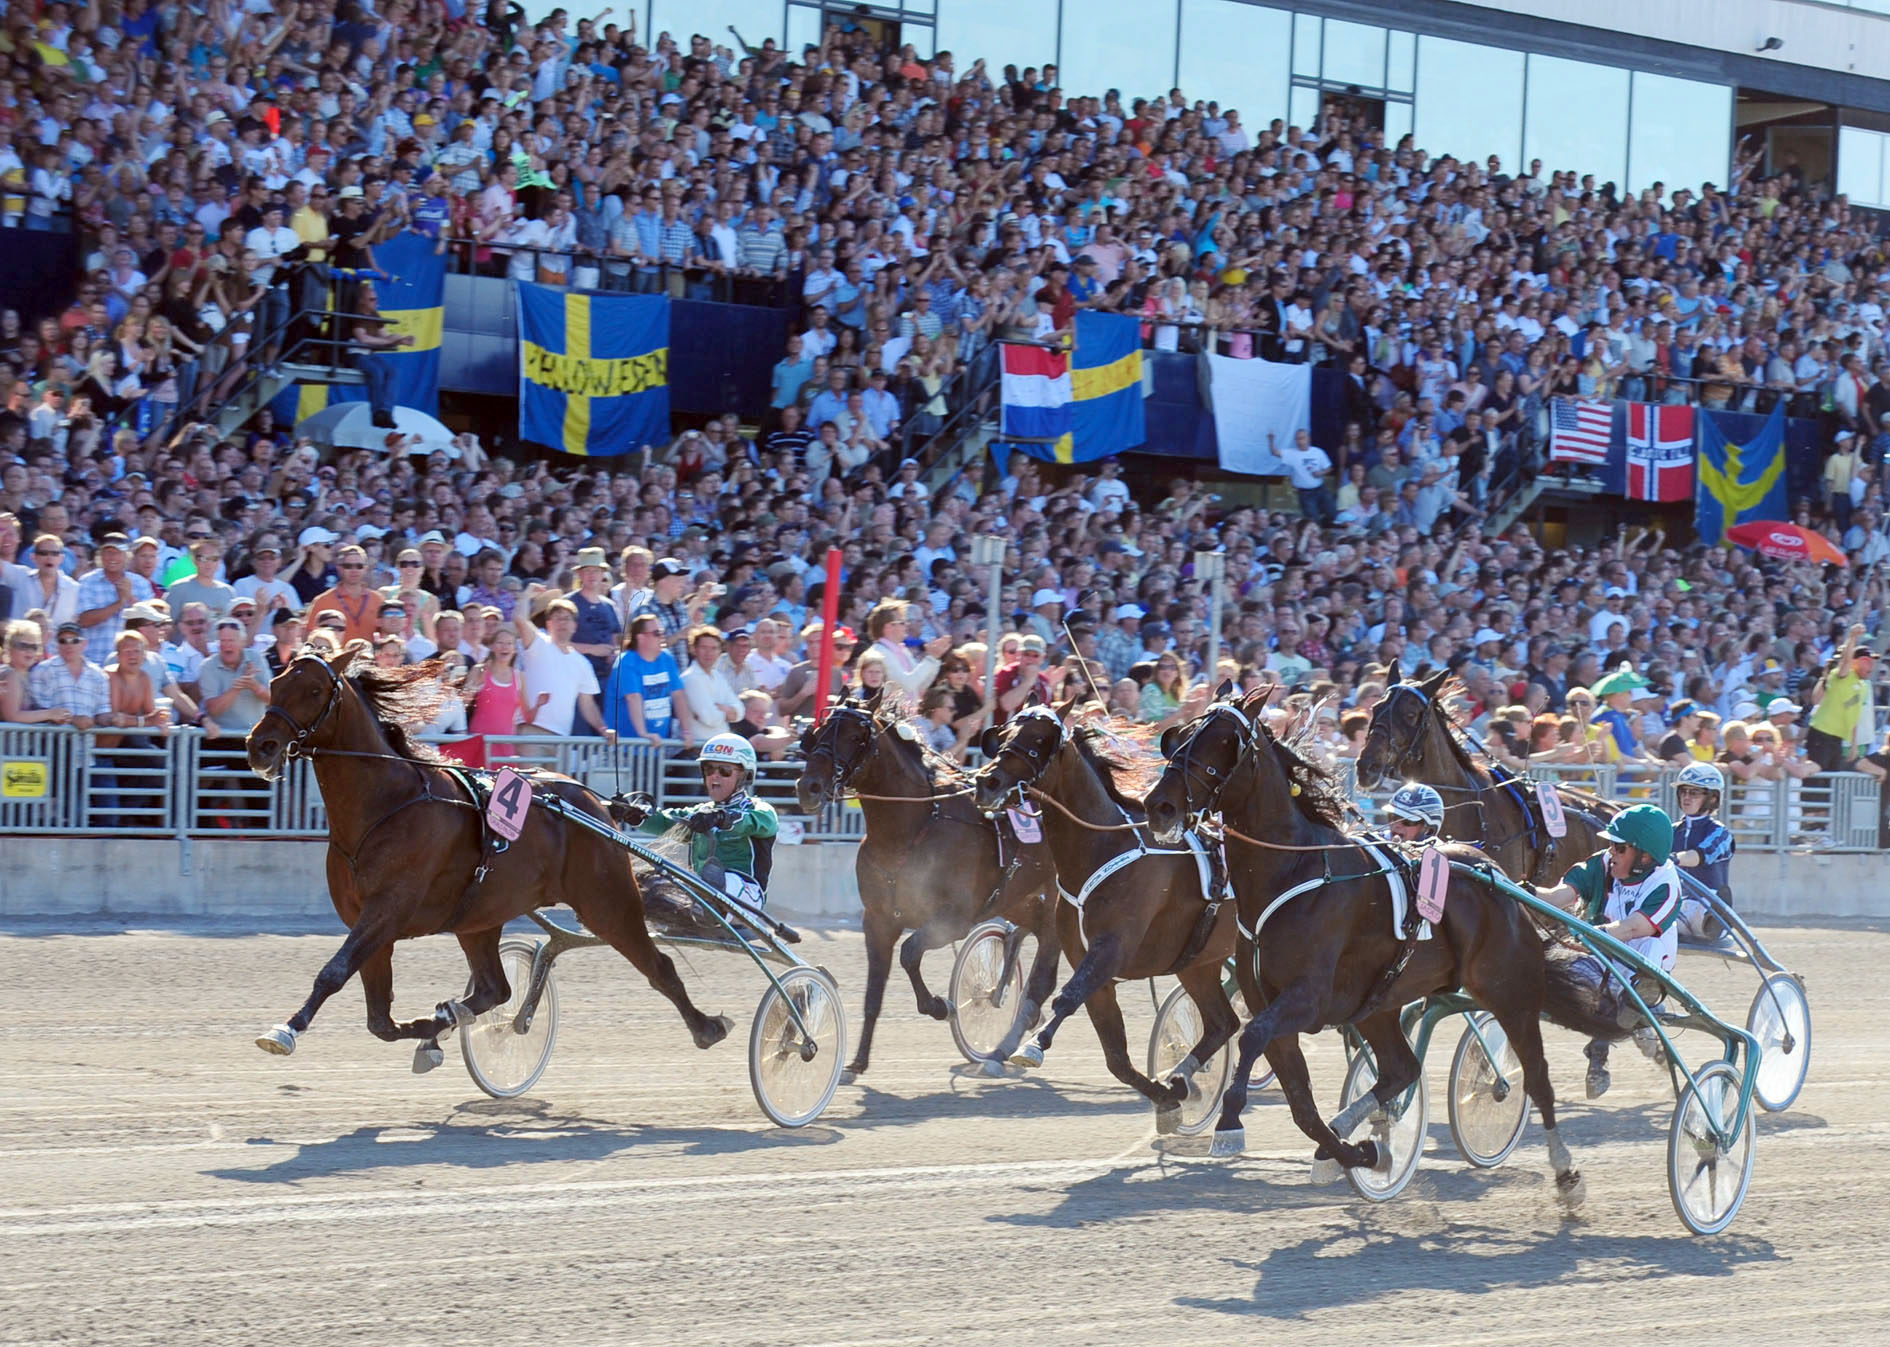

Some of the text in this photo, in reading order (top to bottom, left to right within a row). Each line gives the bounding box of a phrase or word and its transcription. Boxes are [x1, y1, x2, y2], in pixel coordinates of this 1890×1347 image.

[497, 777, 524, 821] 4
[1540, 784, 1559, 821] 5
[1430, 853, 1441, 900] 1
